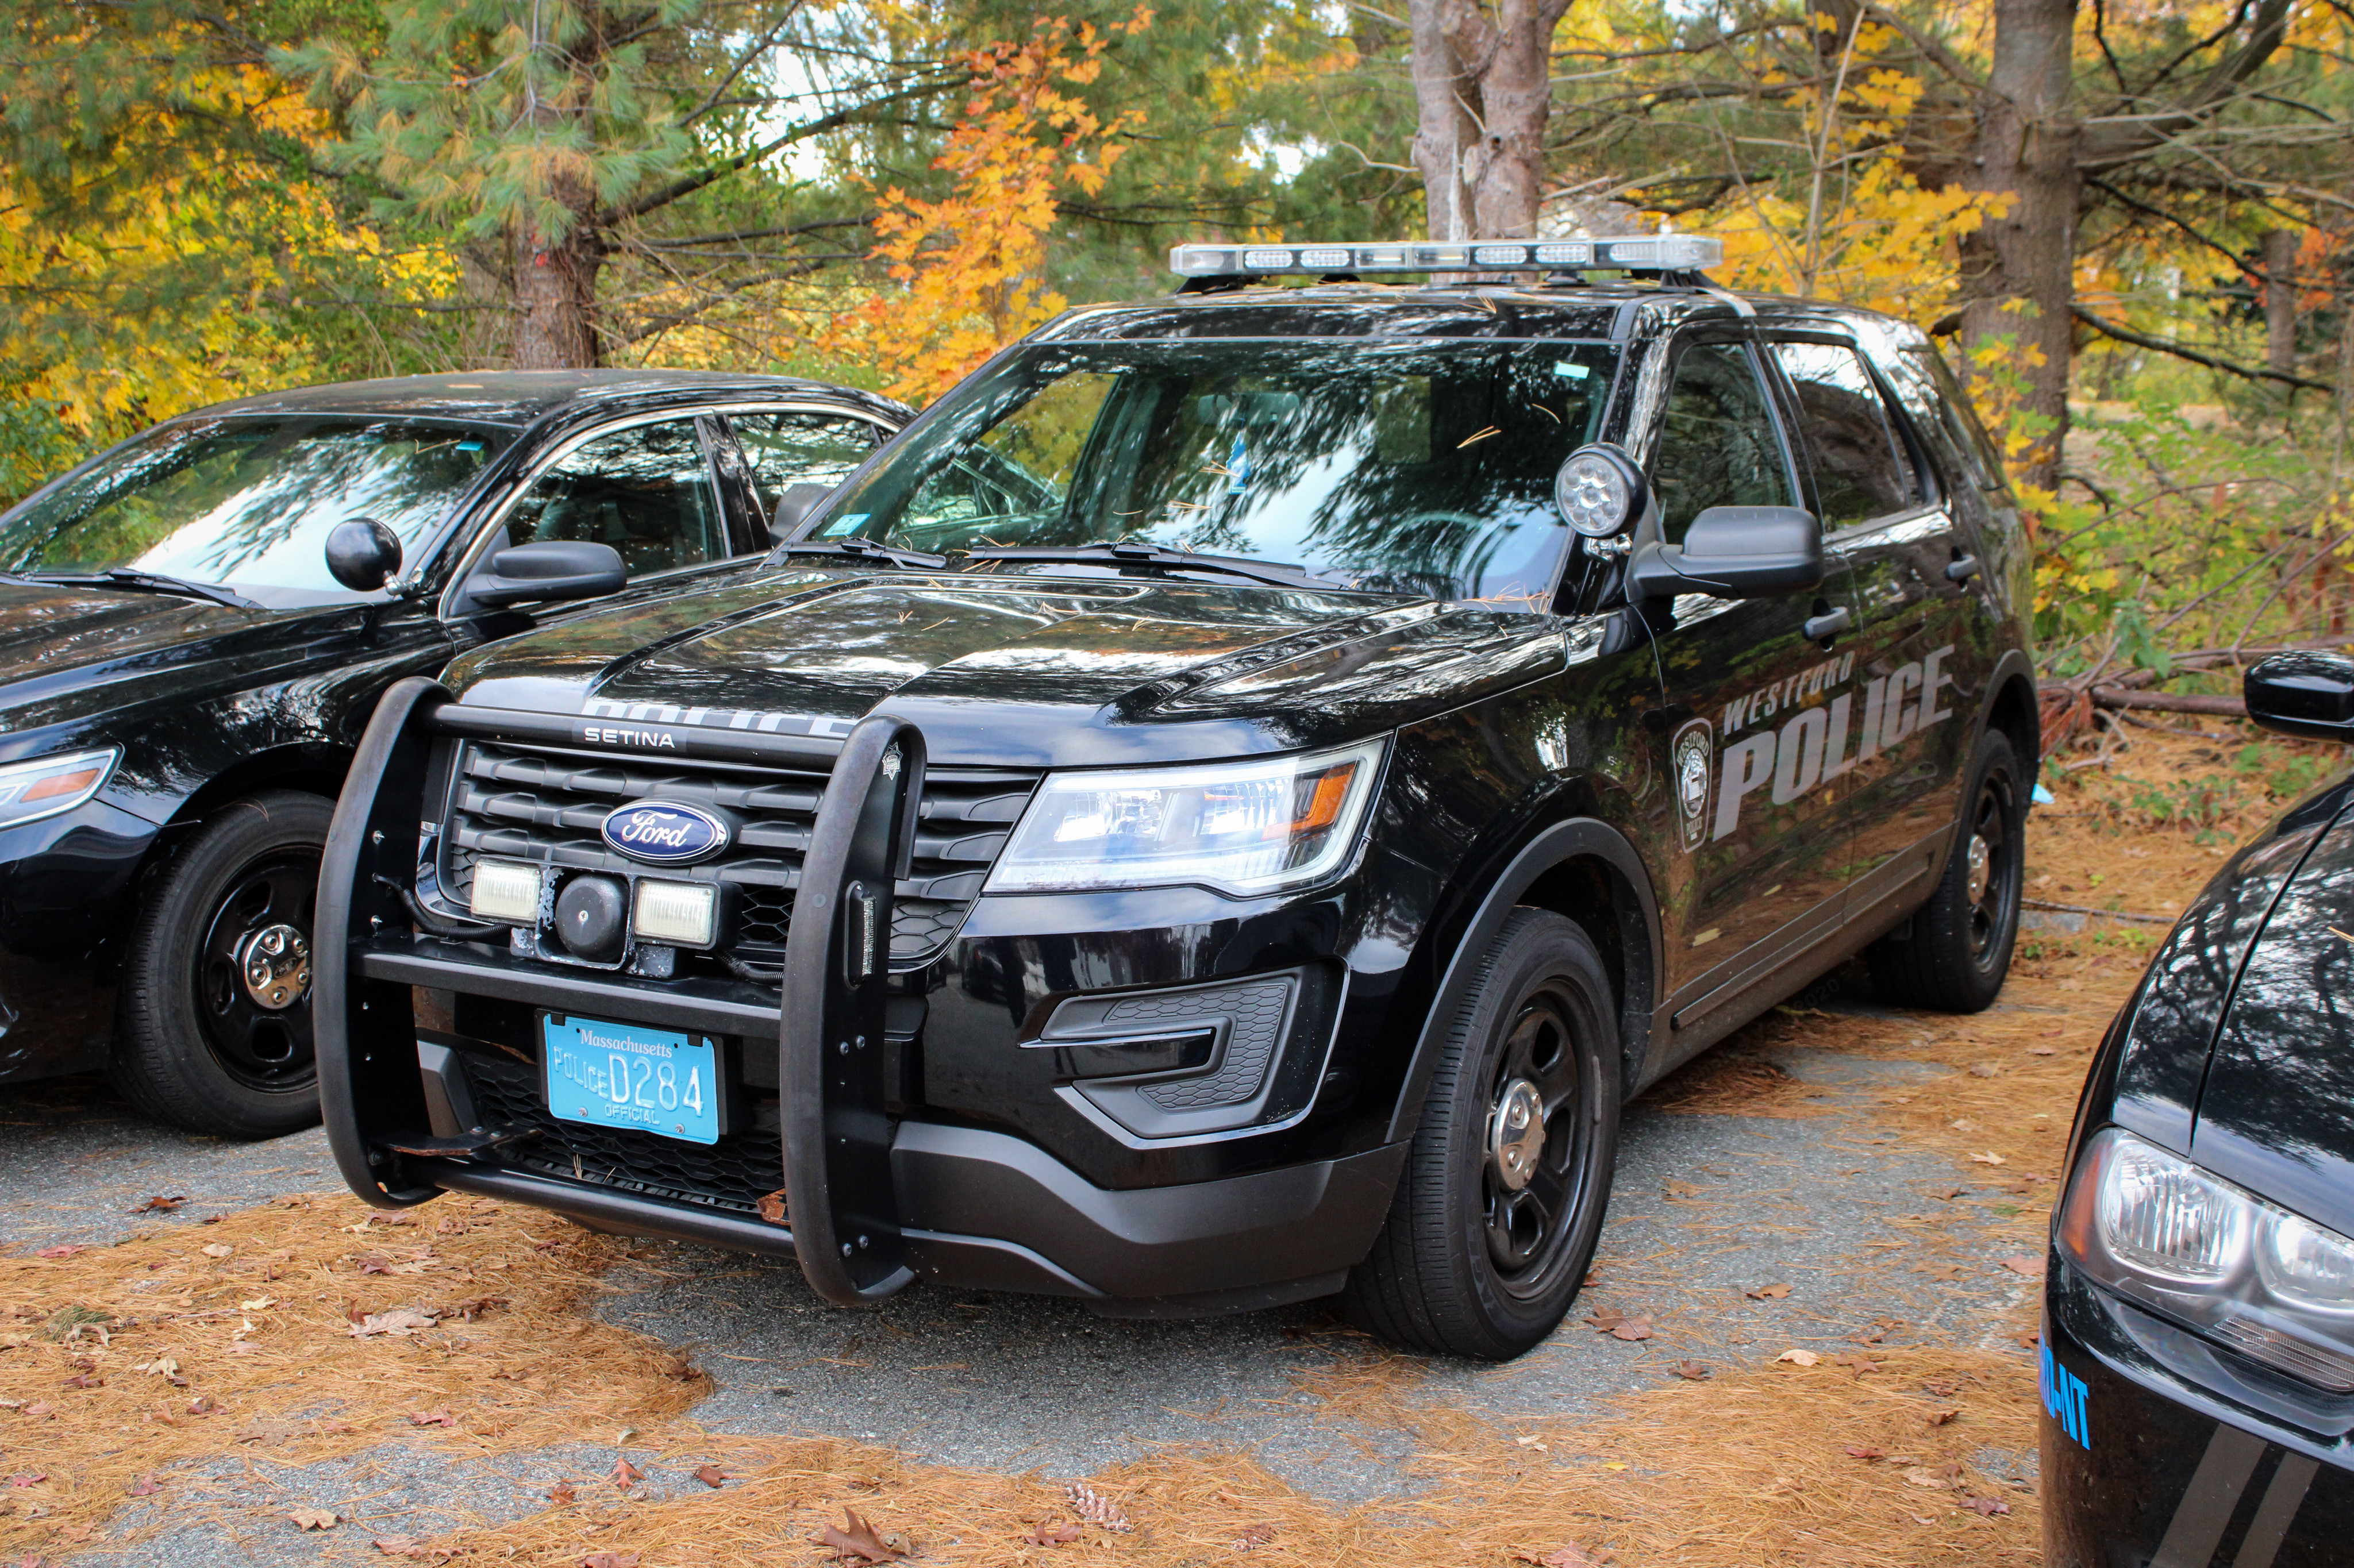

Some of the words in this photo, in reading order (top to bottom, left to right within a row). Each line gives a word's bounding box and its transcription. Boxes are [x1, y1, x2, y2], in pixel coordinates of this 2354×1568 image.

[1723, 650, 1856, 735] WESTFORD
[584, 727, 675, 749] SETINA
[1676, 730, 1709, 767] WESTFORD
[1712, 644, 1956, 843] POLICE
[621, 811, 688, 847] Ford
[580, 1028, 672, 1058] Massachusetts
[553, 1045, 608, 1100] POLICE
[608, 1052, 704, 1117] D284
[604, 1103, 660, 1125] OFFICIAL
